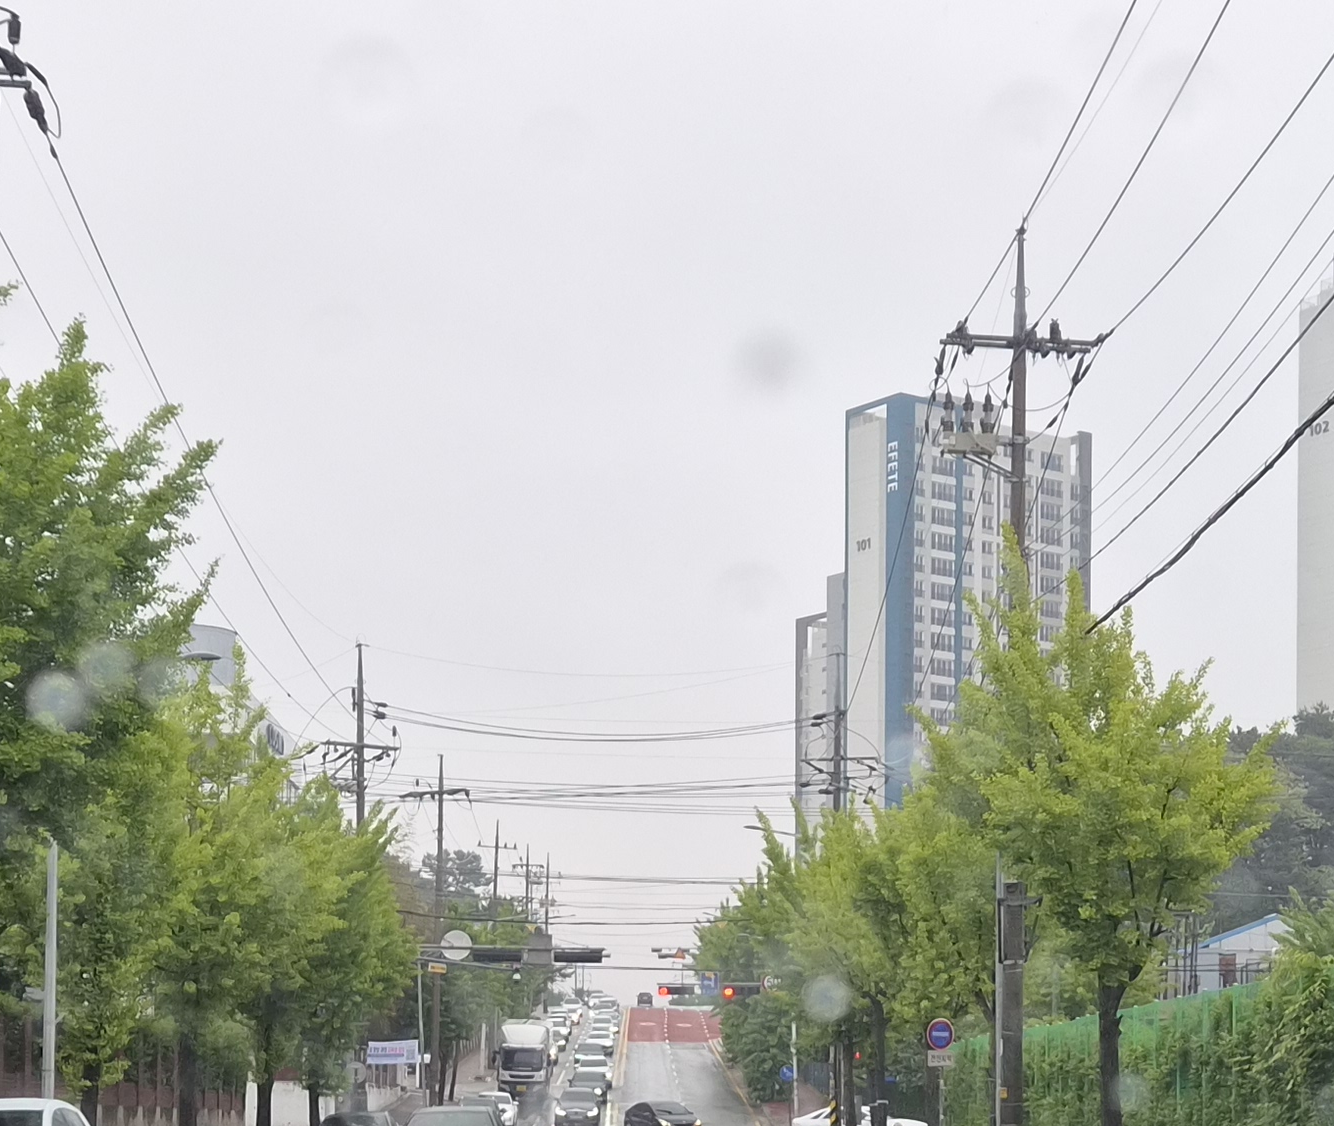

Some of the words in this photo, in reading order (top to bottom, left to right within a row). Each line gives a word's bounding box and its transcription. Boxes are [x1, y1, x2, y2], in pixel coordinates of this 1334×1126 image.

[1309, 420, 1330, 437] 102
[887, 441, 898, 493] EFETE
[856, 537, 872, 552] 101
